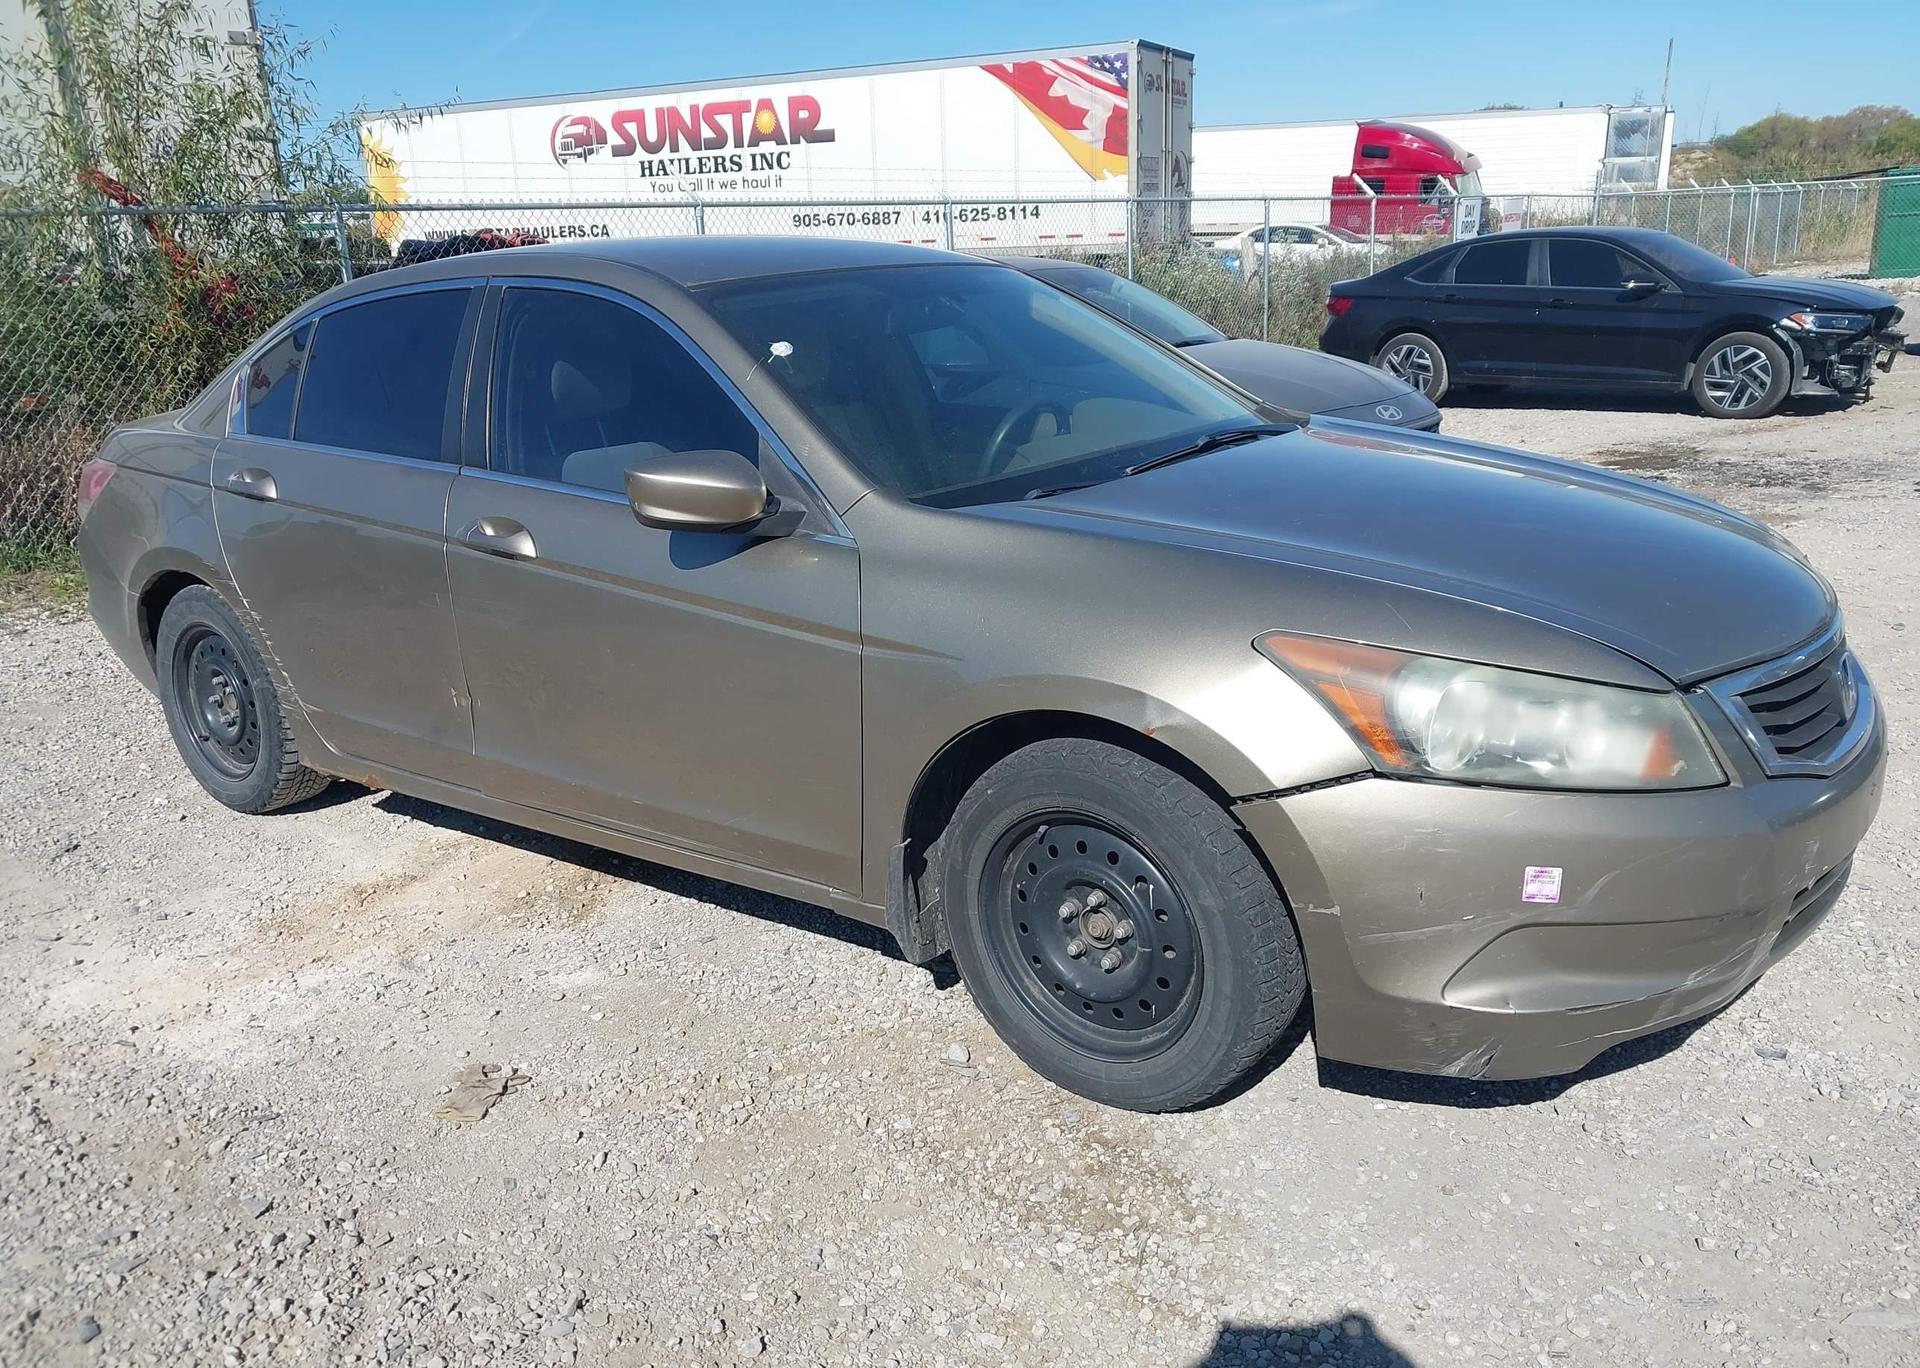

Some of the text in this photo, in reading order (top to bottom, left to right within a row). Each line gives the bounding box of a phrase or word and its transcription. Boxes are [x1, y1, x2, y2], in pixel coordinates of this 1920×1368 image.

[611, 94, 835, 157] SUNSTAR
[639, 151, 791, 177] HAULERS INC
[650, 180, 674, 193] You
[720, 179, 738, 190] we
[742, 175, 771, 189] haul
[775, 174, 782, 188] it
[792, 211, 901, 228] 905-670-6887
[1464, 204, 1476, 218] DAY
[1460, 220, 1476, 234] DROP
